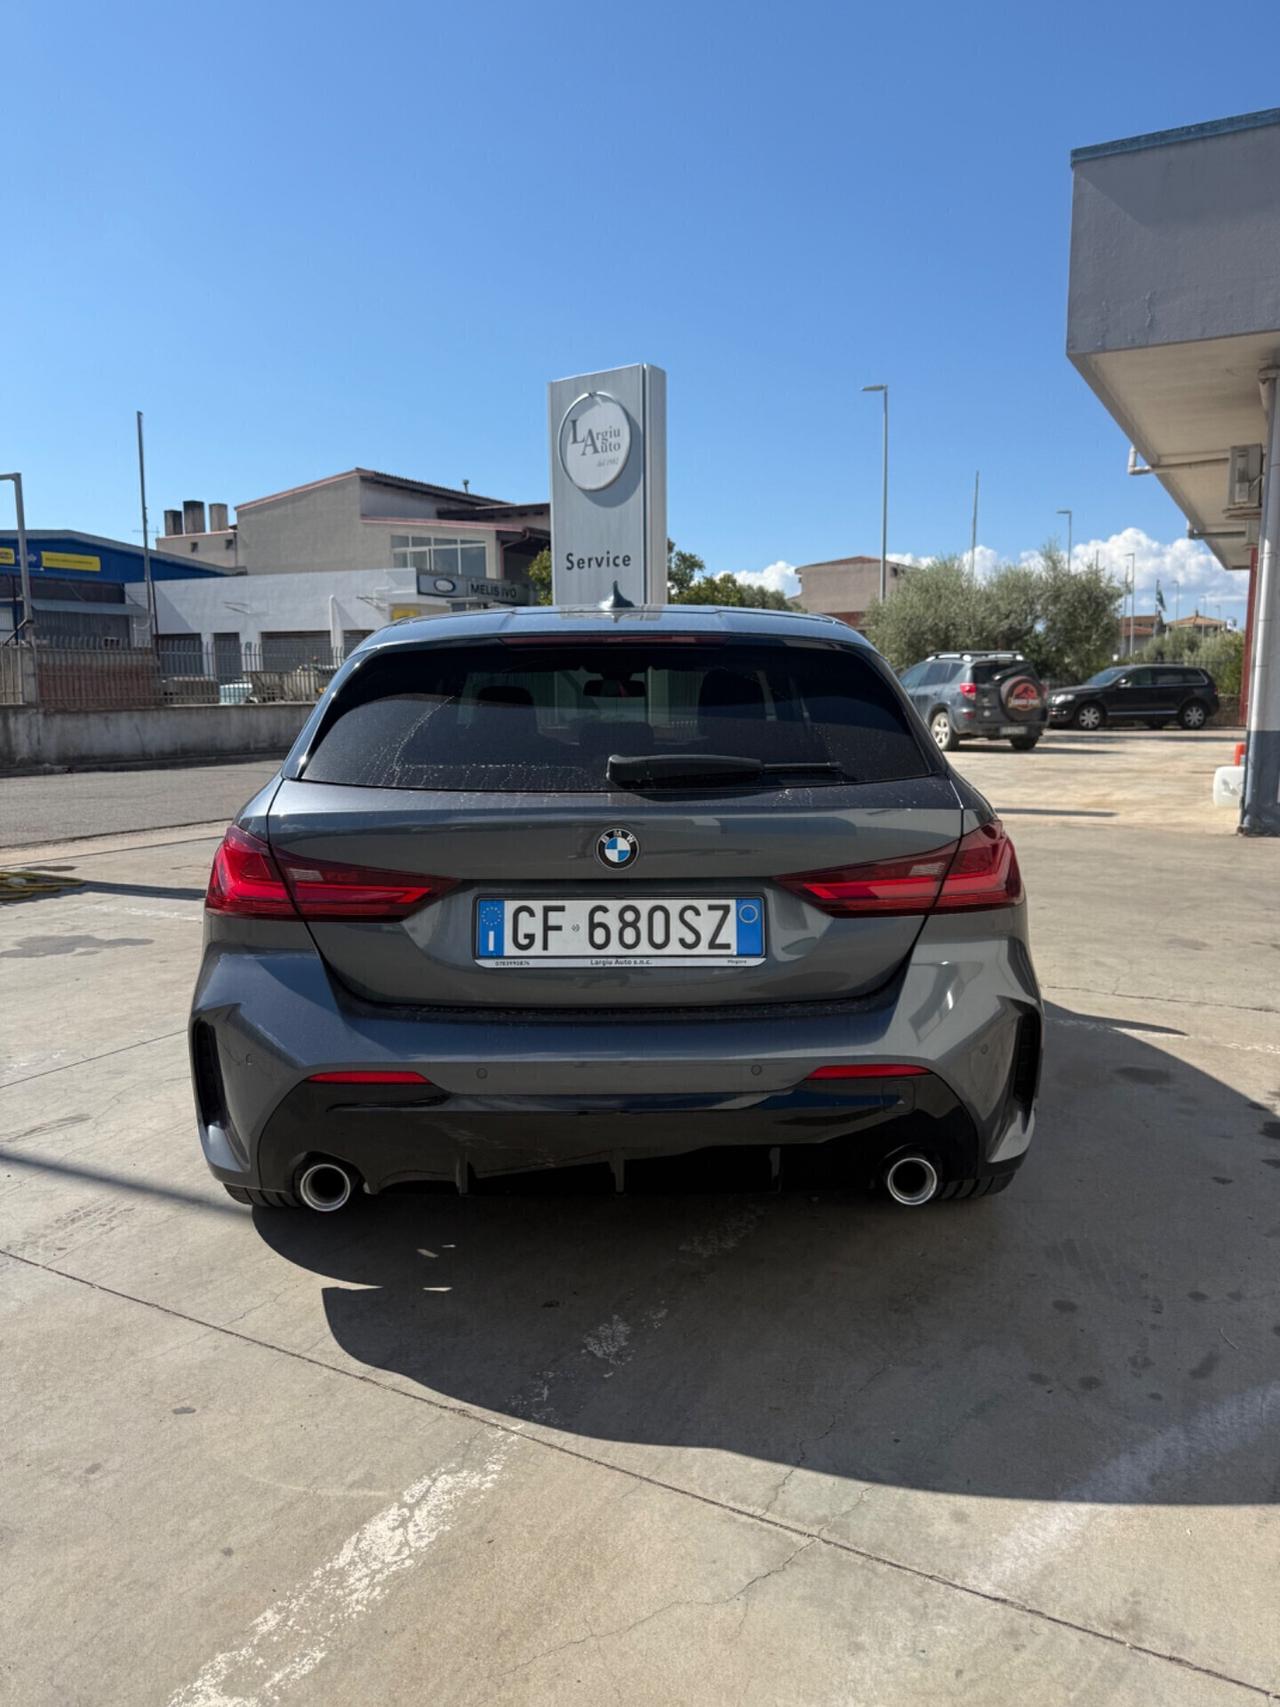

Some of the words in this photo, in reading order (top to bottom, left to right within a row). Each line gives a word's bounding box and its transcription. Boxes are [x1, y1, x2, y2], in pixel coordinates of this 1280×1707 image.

[566, 550, 631, 571] Service
[470, 583, 499, 597] MELIS
[600, 830, 636, 843] BMW
[512, 905, 566, 951] GF
[588, 904, 732, 951] 680SZ
[590, 959, 613, 967] Largiu
